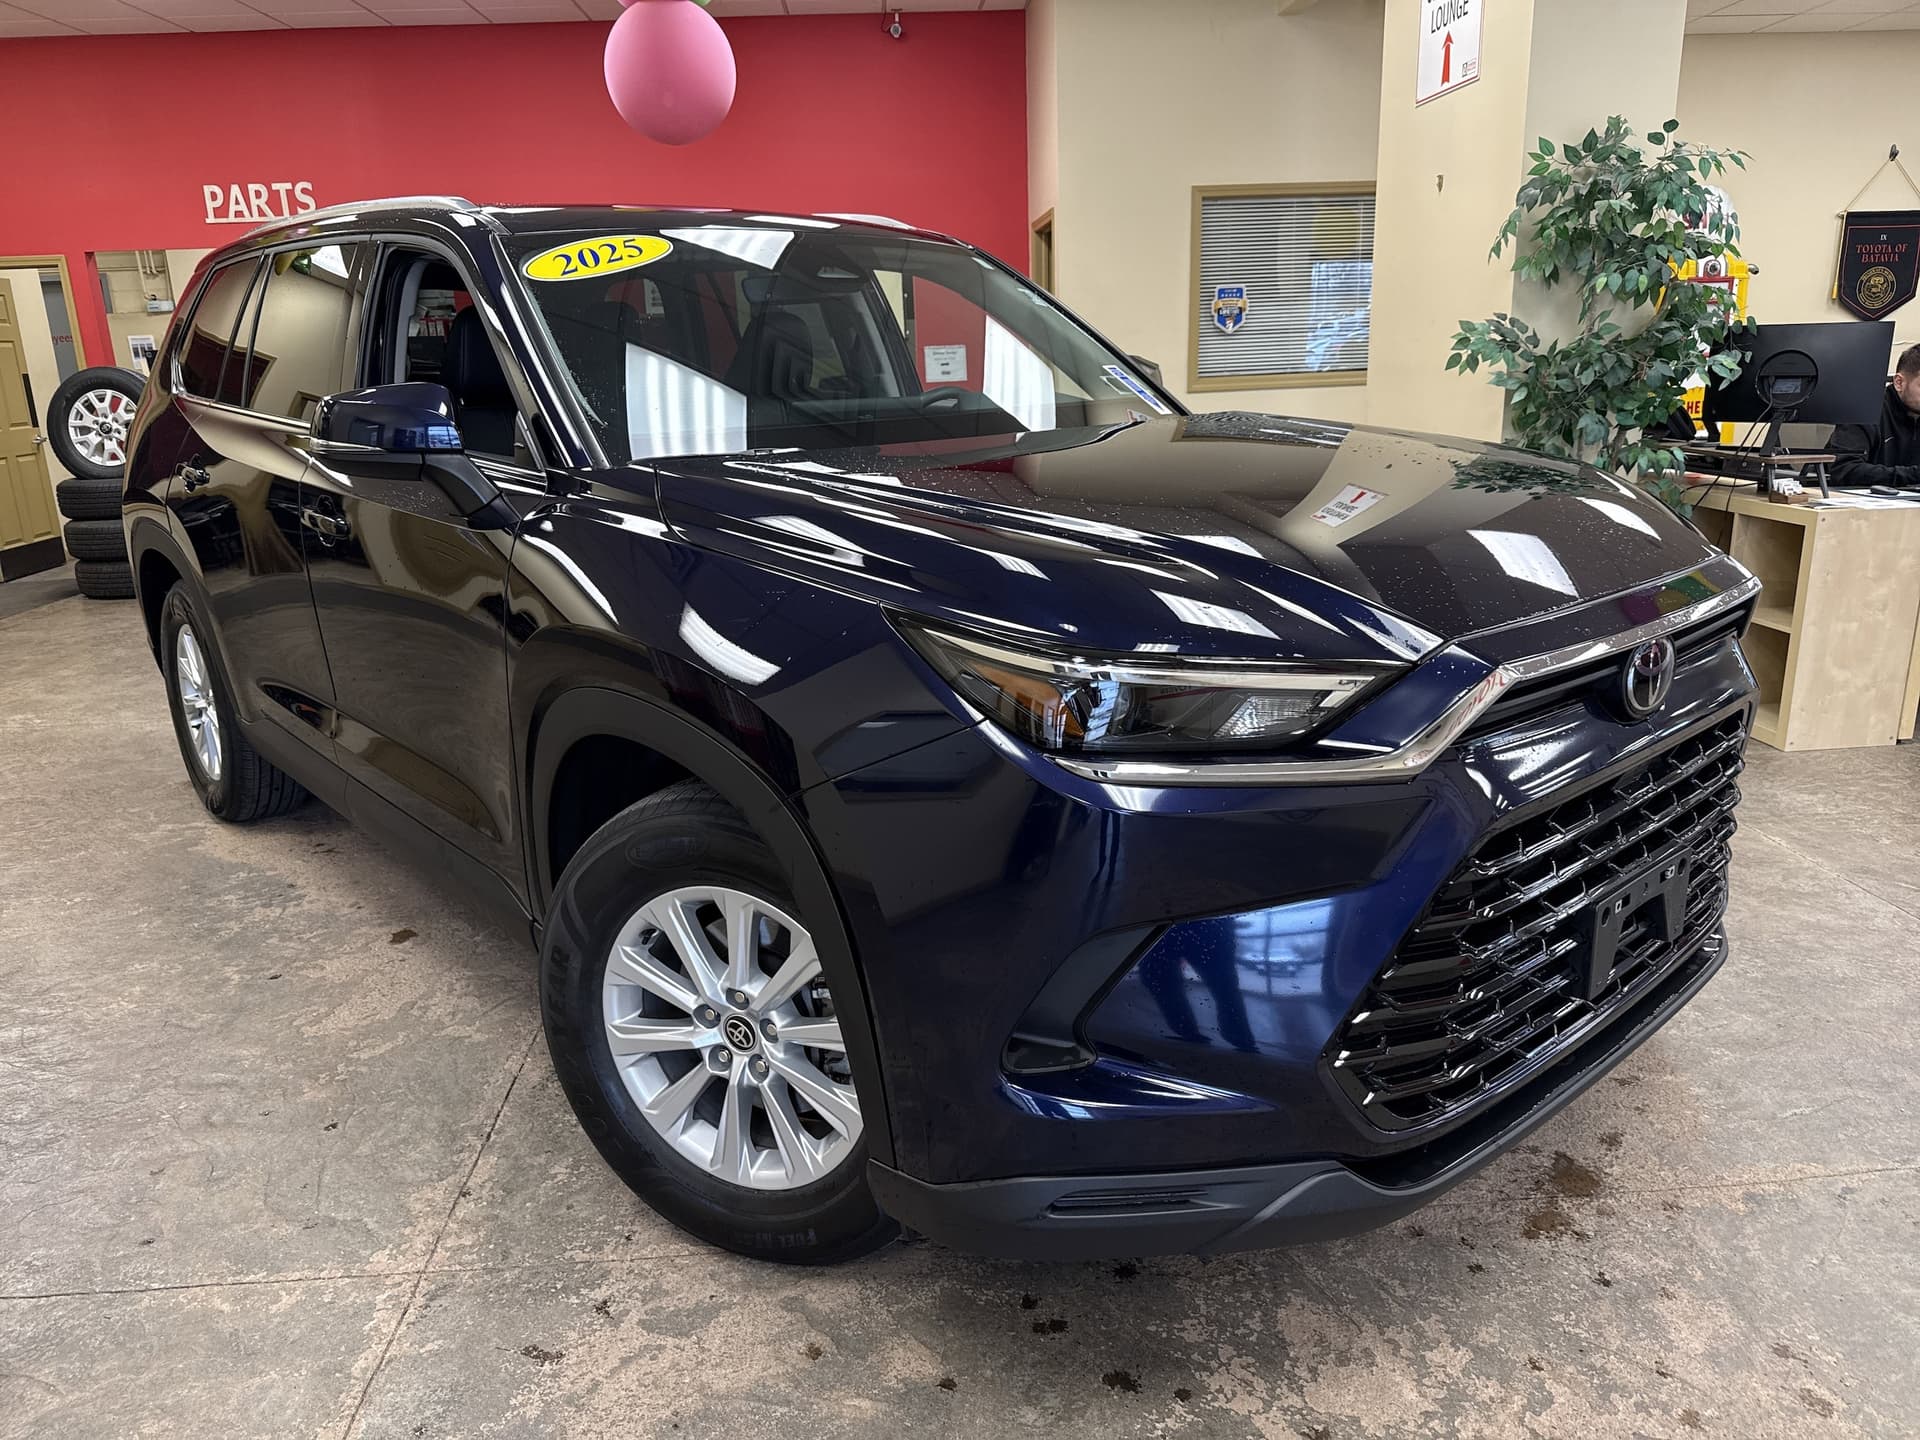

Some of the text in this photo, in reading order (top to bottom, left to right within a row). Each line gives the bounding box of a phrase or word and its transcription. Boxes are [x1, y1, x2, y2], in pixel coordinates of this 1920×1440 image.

[1431, 0, 1469, 34] LOUNGE
[202, 181, 316, 220] PARTS
[552, 238, 643, 276] 2025
[1856, 243, 1908, 254] TOYOTA OF
[1861, 253, 1899, 263] BATAVIA
